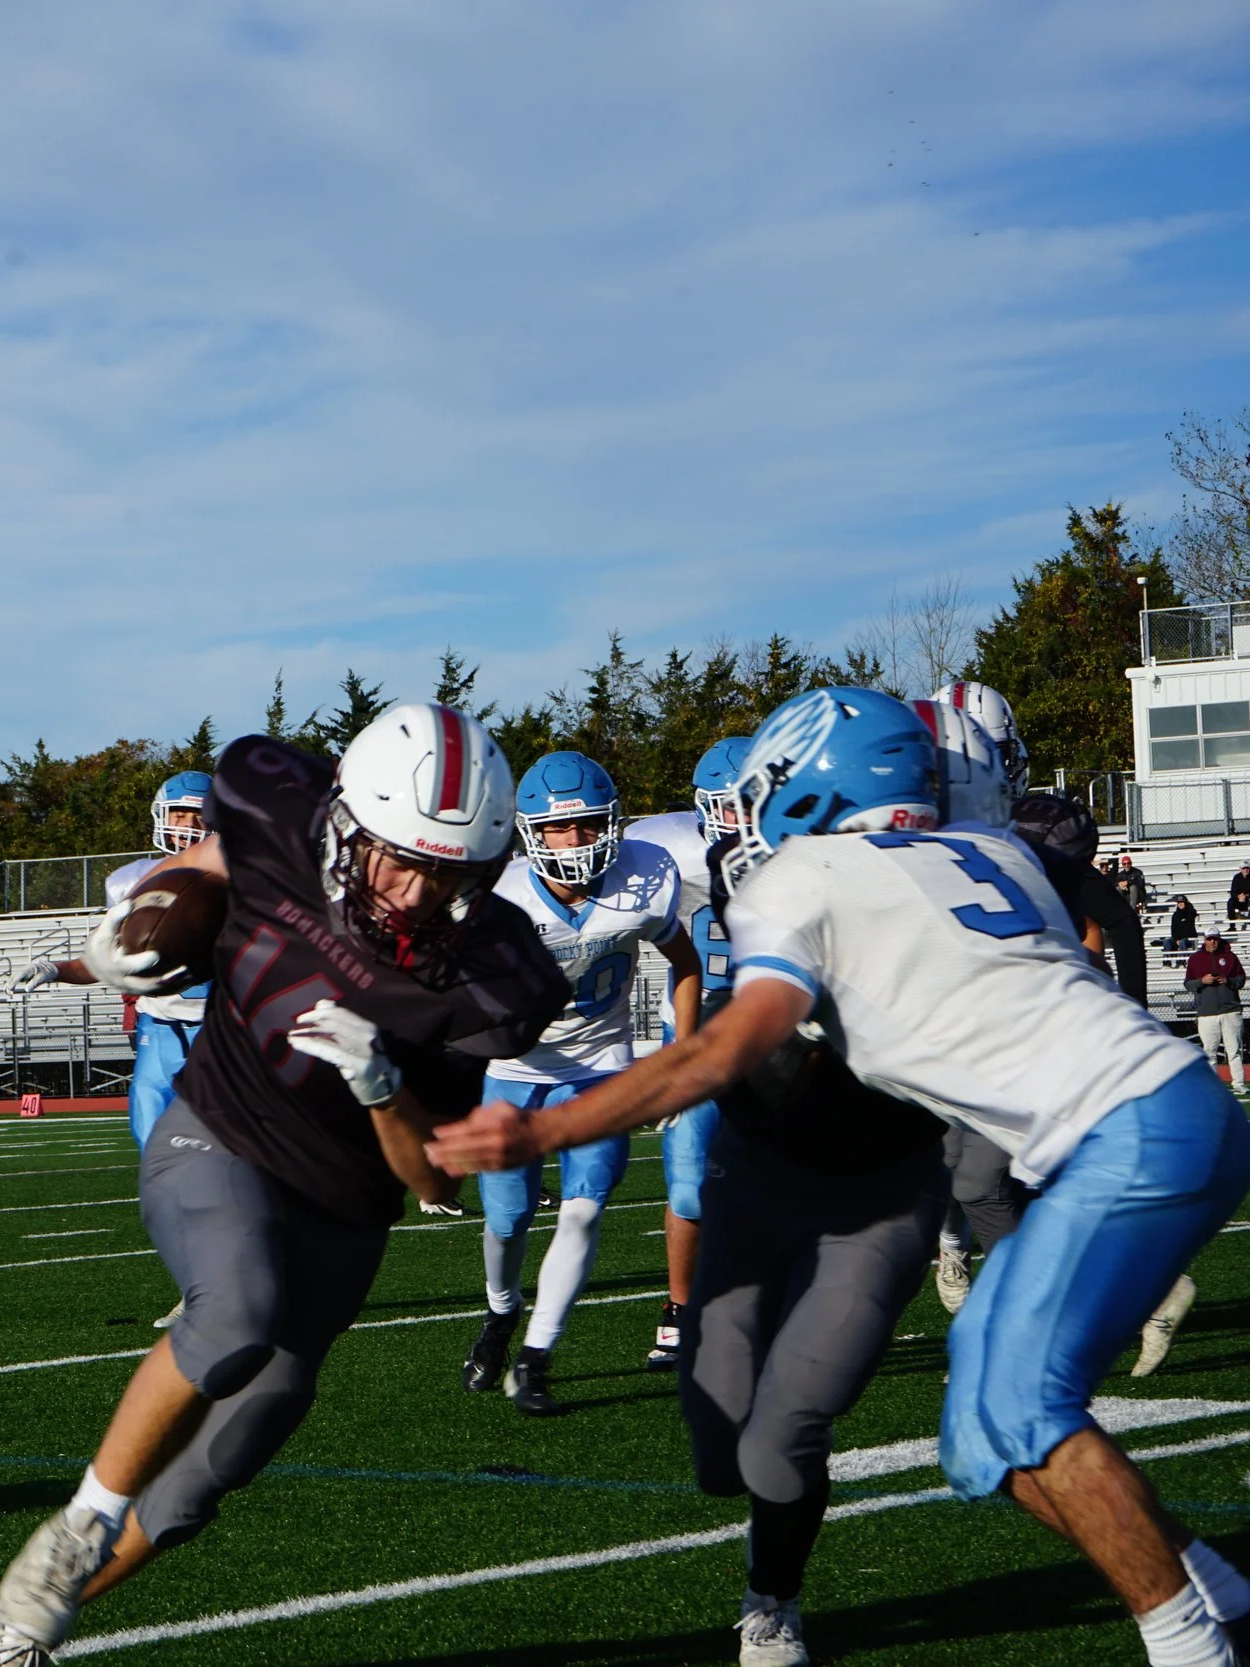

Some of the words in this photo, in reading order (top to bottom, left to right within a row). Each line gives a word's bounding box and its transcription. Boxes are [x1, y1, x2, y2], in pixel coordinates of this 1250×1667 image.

[415, 838, 464, 857] Riddell
[862, 832, 1046, 940] 3
[558, 951, 632, 1020] 0
[21, 1096, 37, 1114] 40
